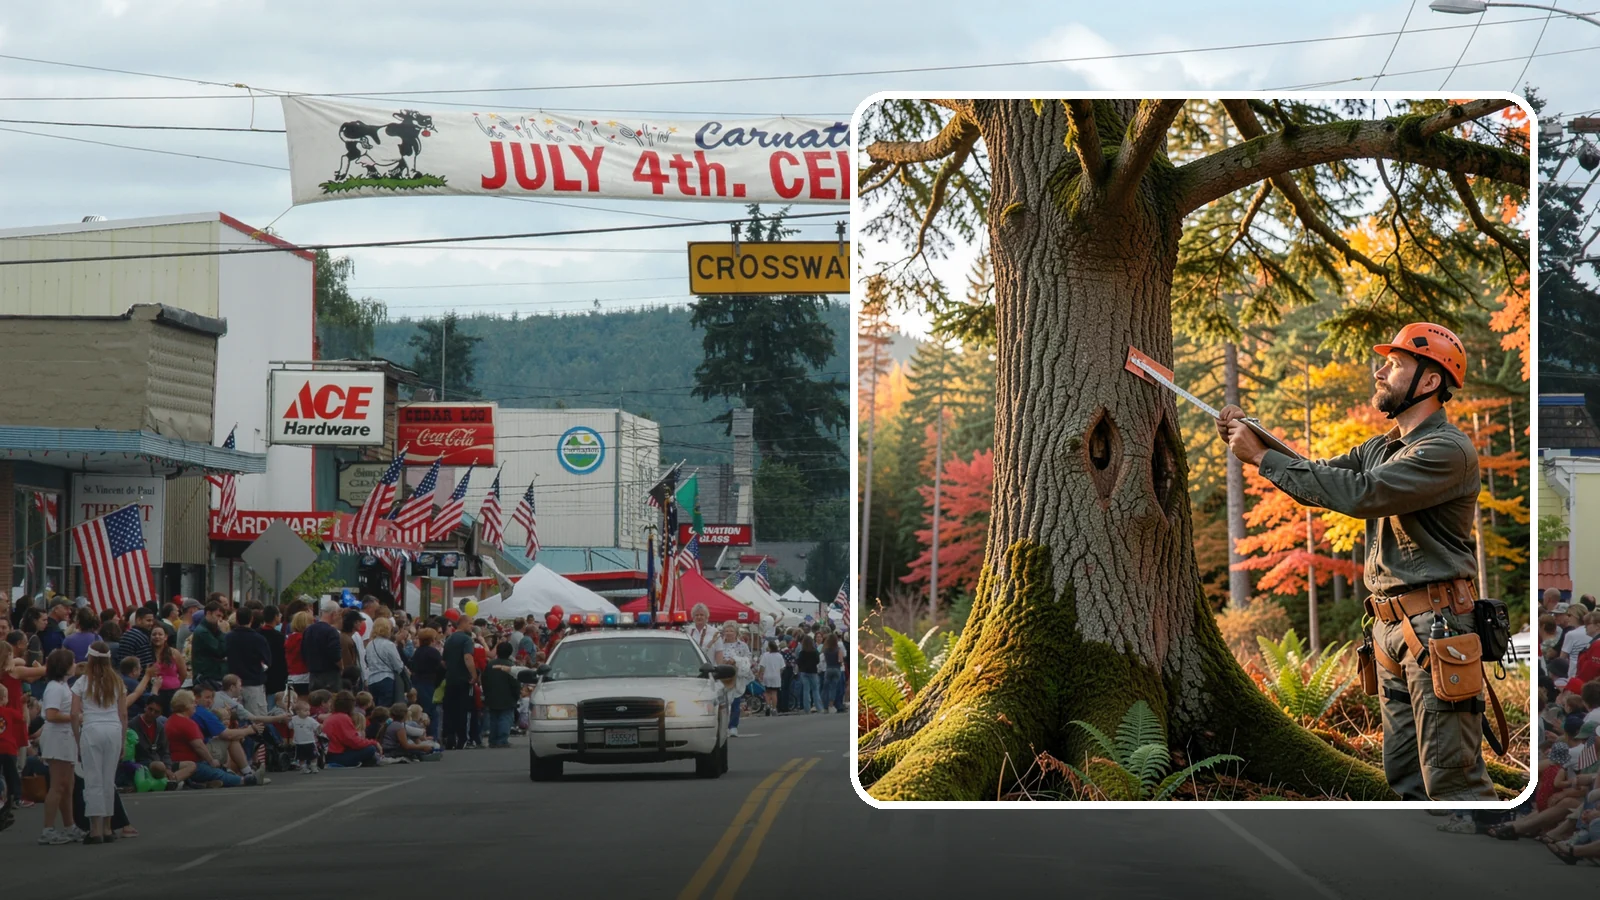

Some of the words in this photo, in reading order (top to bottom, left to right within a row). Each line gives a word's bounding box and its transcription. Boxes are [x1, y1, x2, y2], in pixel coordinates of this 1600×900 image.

[481, 141, 604, 192] JULY
[632, 149, 746, 198] 4th.
[697, 254, 850, 280] CROSSWA
[283, 380, 373, 420] ACE
[406, 409, 452, 421] CEDAR
[283, 421, 371, 436] Hardware
[416, 428, 477, 446] Coca-Cola
[353, 467, 386, 480] Simpl
[83, 485, 93, 494] St.
[95, 485, 124, 494] Vincent
[126, 485, 136, 494] de
[138, 486, 155, 495] Paul
[81, 503, 153, 522] THT
[688, 526, 741, 535] CRNATION
[699, 535, 730, 543] GLASS
